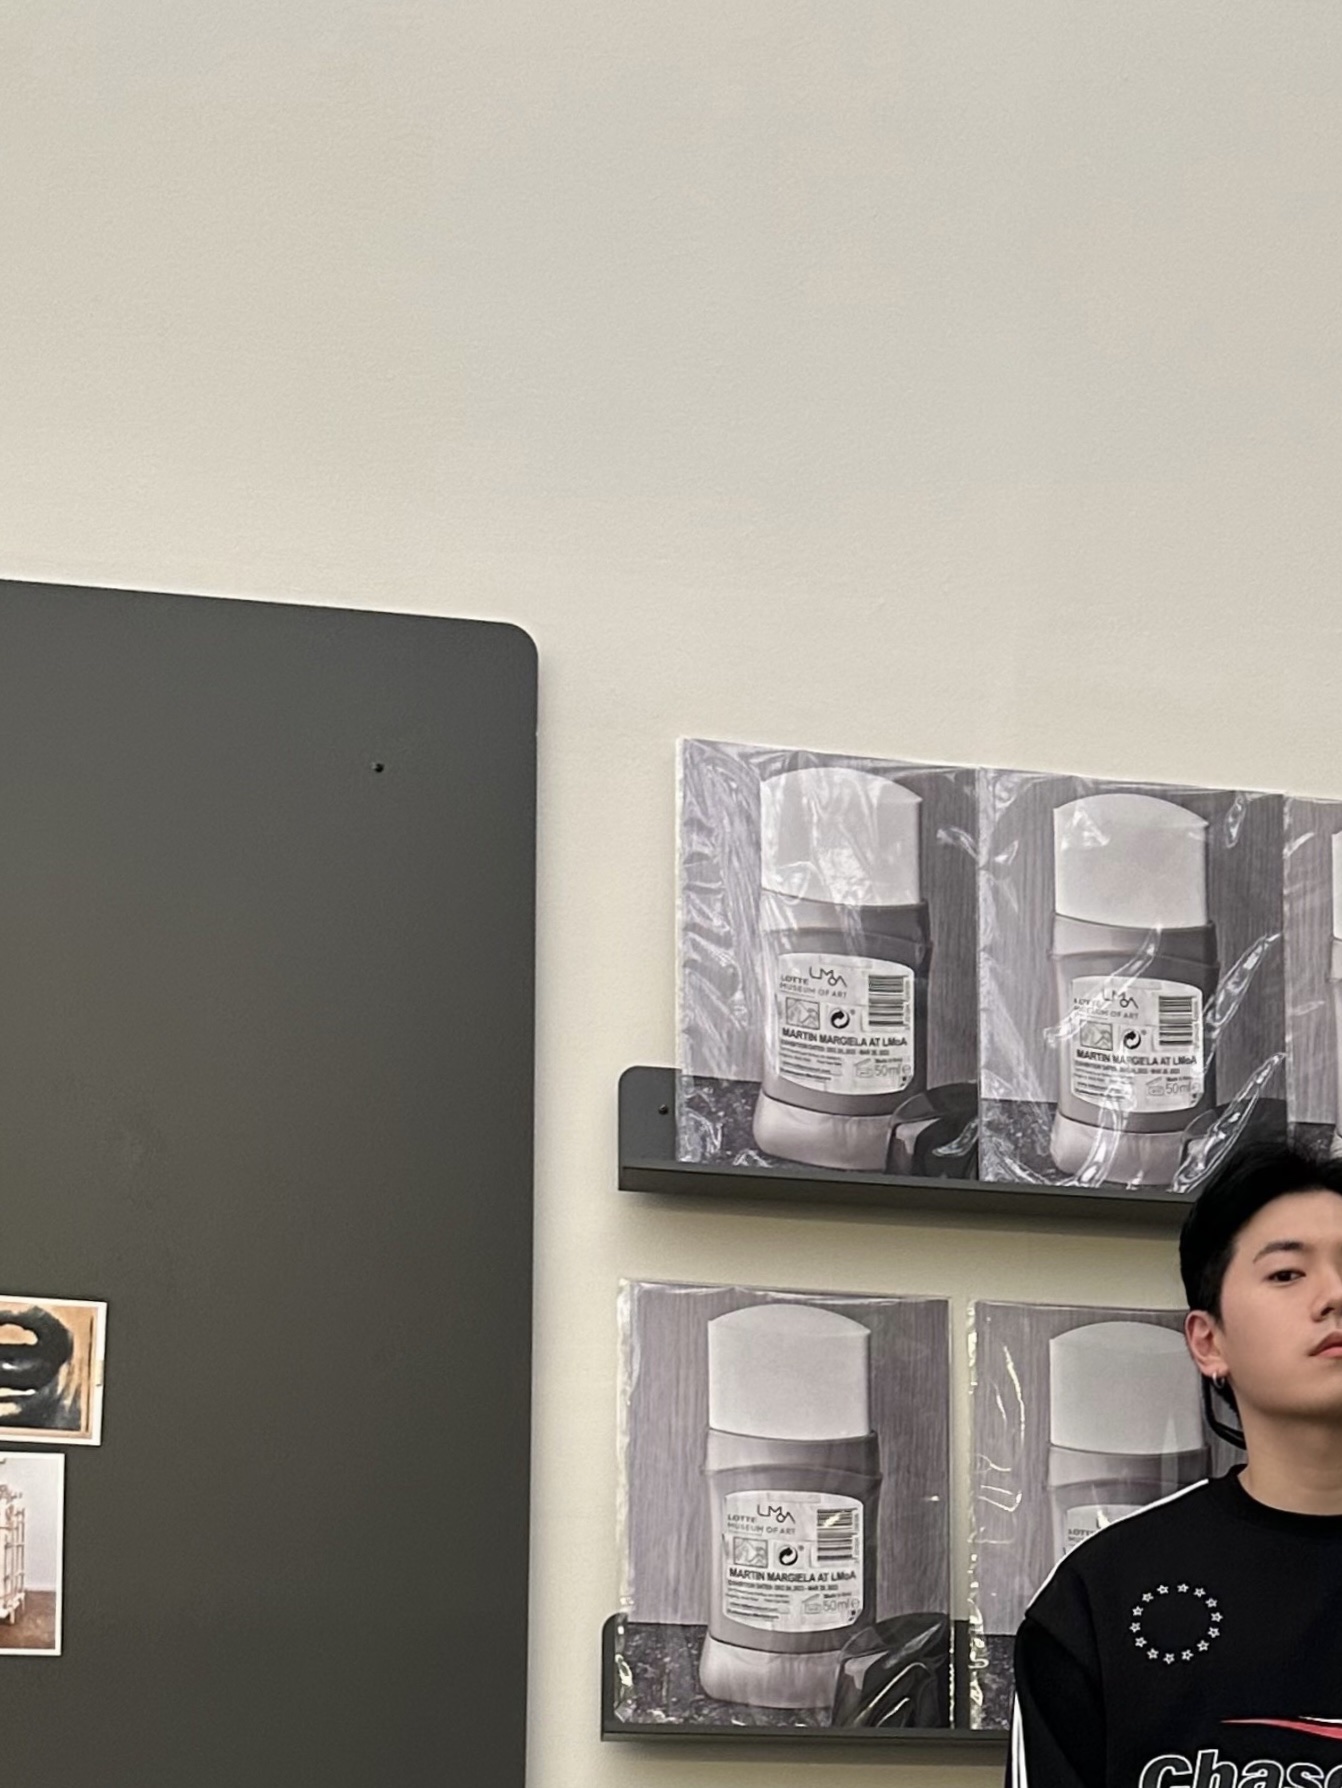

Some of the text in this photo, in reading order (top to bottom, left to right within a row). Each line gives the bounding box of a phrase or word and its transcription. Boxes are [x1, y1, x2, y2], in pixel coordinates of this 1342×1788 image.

[780, 975, 809, 985] LOTTE
[780, 982, 816, 994] MUSEUM
[818, 988, 830, 996] OF
[1124, 1011, 1139, 1020] ART
[782, 1027, 817, 1042] MARTIN
[820, 1034, 868, 1047] MARGIELA
[868, 1037, 881, 1046] AT
[1077, 1049, 1110, 1062] MARTIN
[1160, 1057, 1172, 1066] AT
[727, 1514, 756, 1523] LOTTE
[727, 1522, 764, 1532] MUSEUM
[729, 1568, 765, 1581] MARTIN
[767, 1572, 816, 1583] MARGIELA
[817, 1573, 829, 1581] AT
